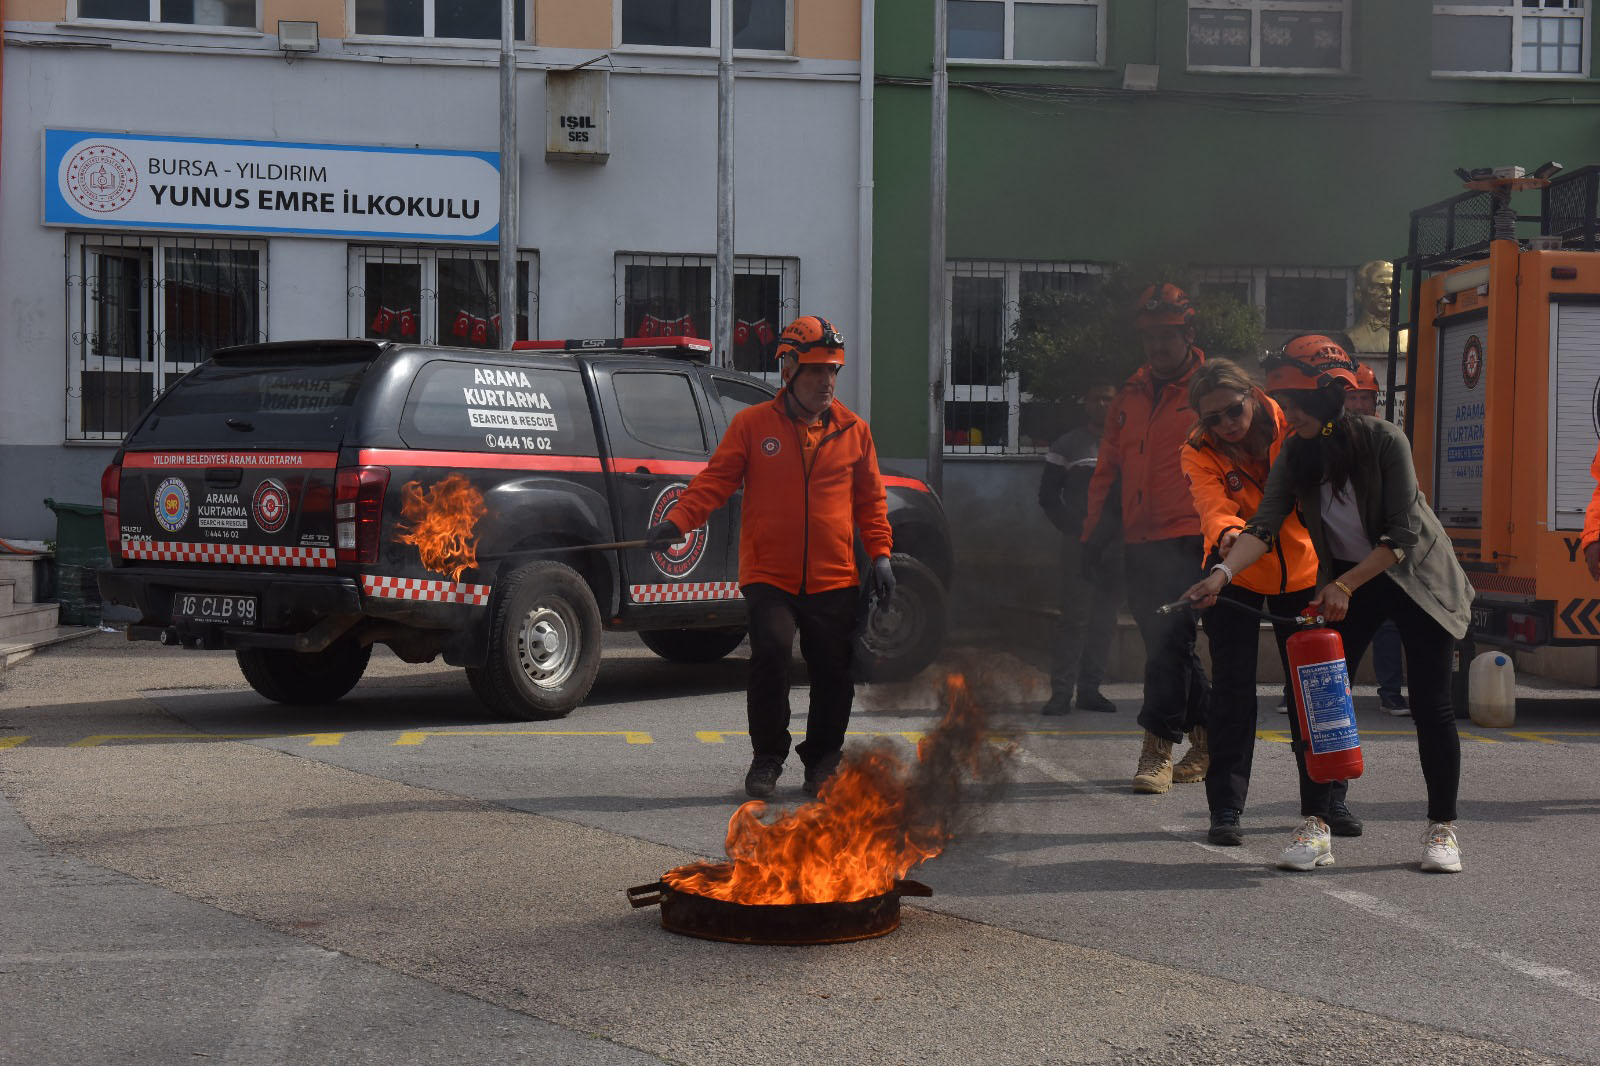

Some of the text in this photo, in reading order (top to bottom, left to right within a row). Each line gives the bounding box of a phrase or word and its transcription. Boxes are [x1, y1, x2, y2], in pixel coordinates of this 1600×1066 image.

[560, 115, 596, 130] IŞIL
[568, 131, 589, 142] SES
[148, 157, 218, 178] BURSA
[236, 162, 327, 183] YILDIRIM
[149, 184, 480, 220] YUNUS EMRE İLKOKULU
[474, 368, 532, 389] ARAMA
[463, 387, 552, 410] KURTARMA
[472, 413, 555, 428] SEARCH & RESCUE
[497, 435, 552, 451] 444 16 02
[153, 454, 303, 465] YILDIRIM BELEDİYESİ ARAMA KURTARMA
[206, 493, 239, 504] ARAMA
[198, 505, 248, 517] KURTARMA
[121, 525, 142, 533] ISUZU
[222, 530, 230, 538] 16
[230, 530, 239, 539] 02
[121, 533, 153, 542] D-MAX
[182, 596, 255, 618] 16 CLB 99
